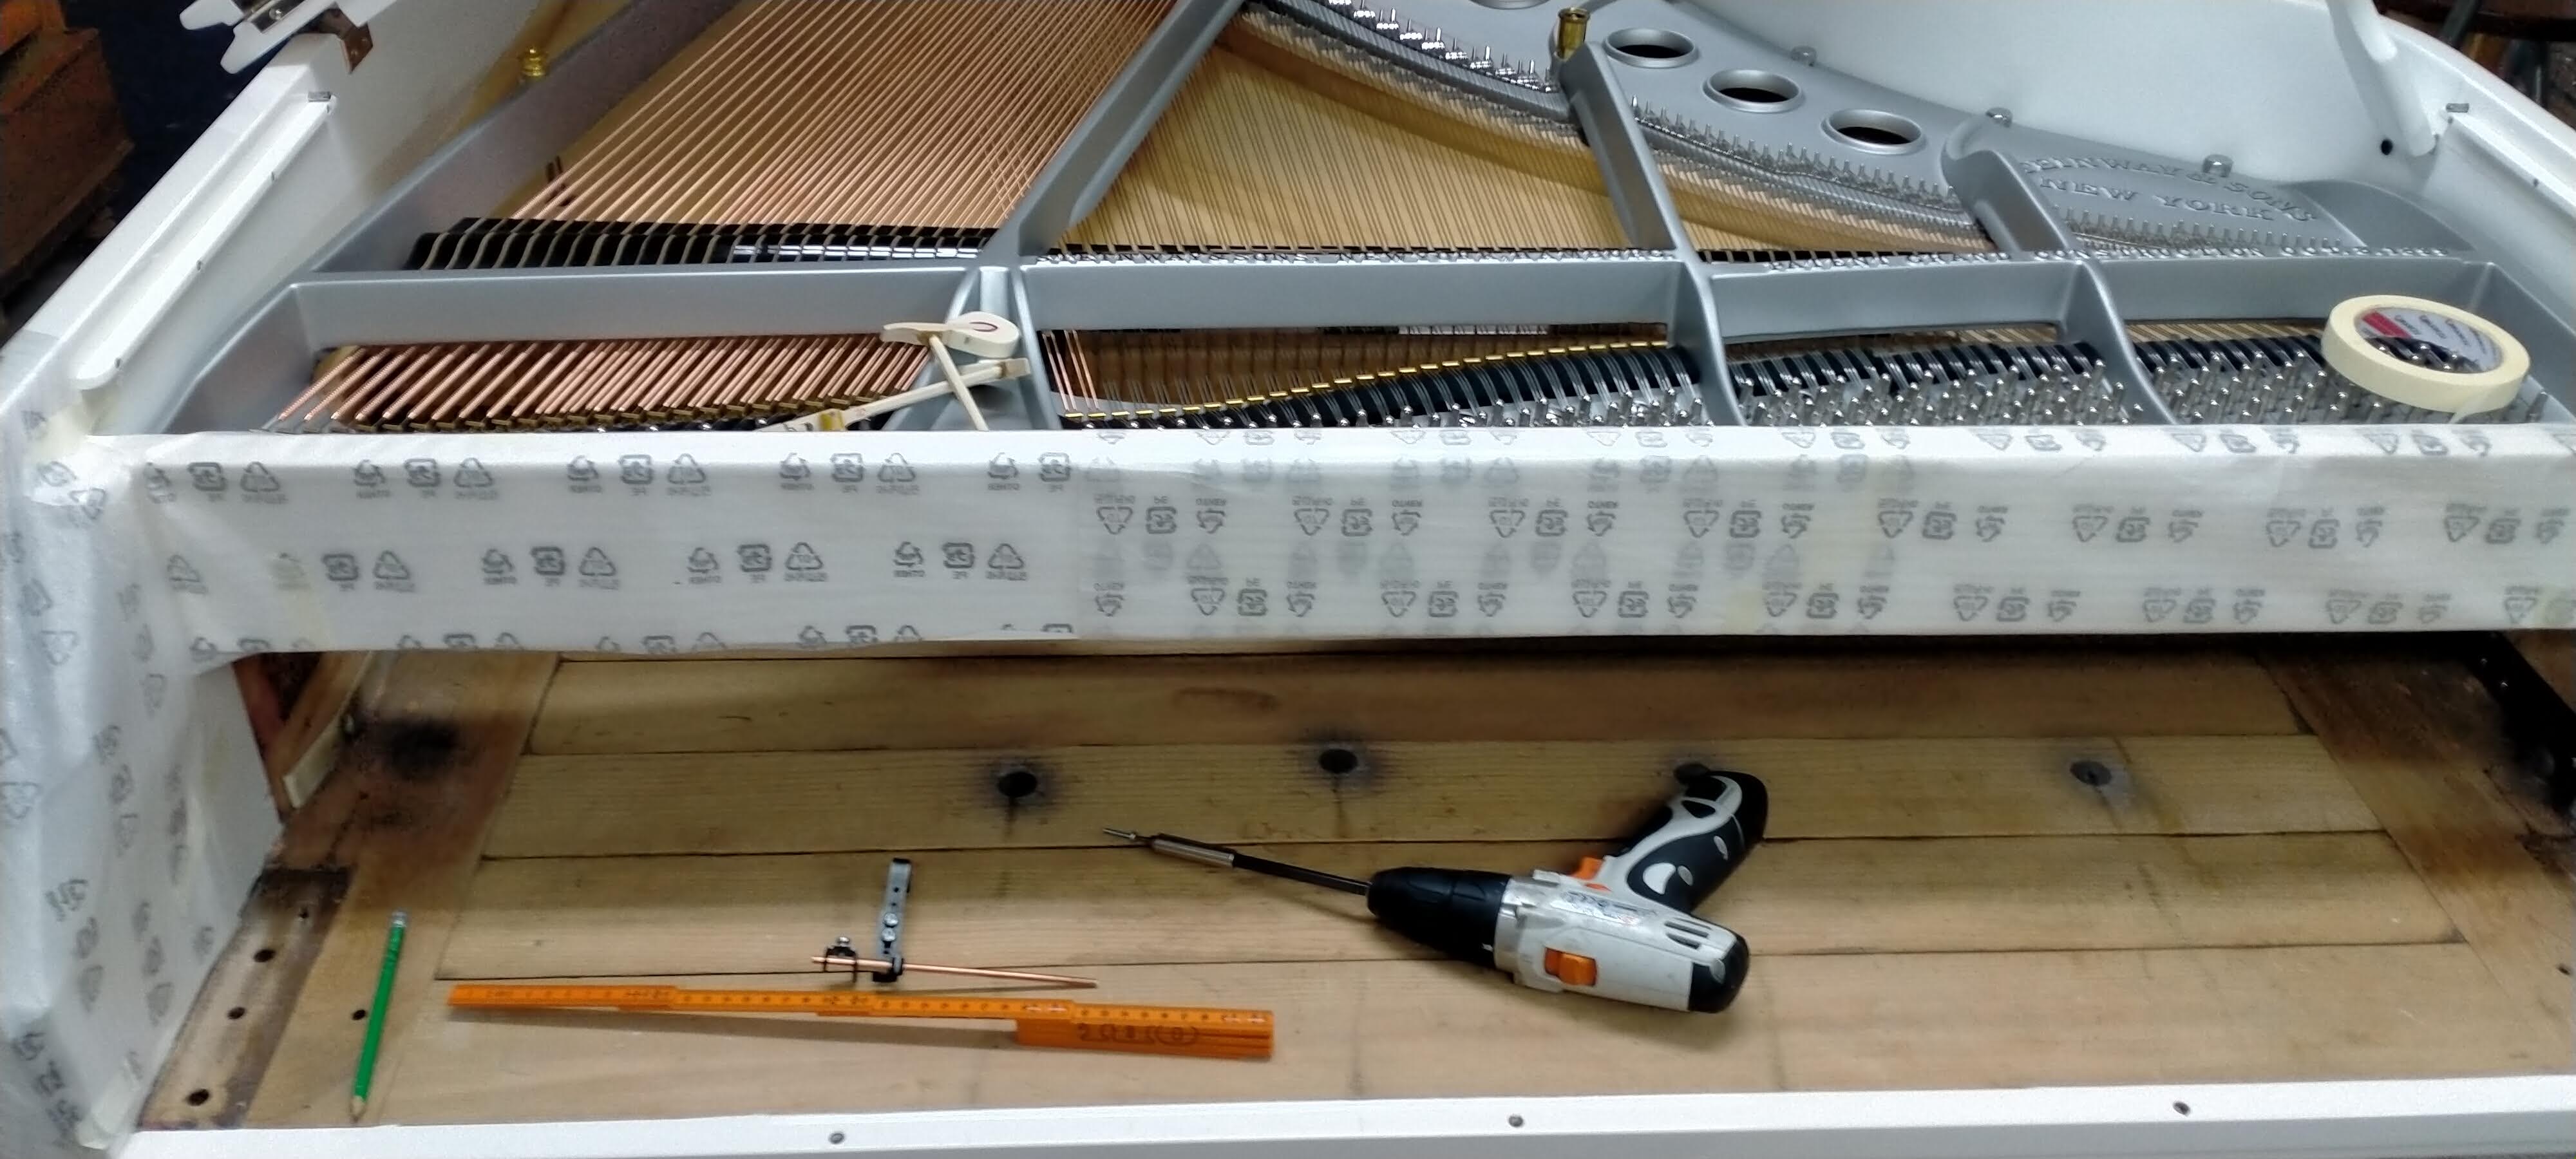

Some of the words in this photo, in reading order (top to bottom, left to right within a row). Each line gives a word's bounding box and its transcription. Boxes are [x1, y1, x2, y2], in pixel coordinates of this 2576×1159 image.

[2020, 156, 2181, 176] EINWAY
[2038, 176, 2139, 201] NEW
[2152, 195, 2275, 221] YORK
[1337, 252, 1405, 265] NEW
